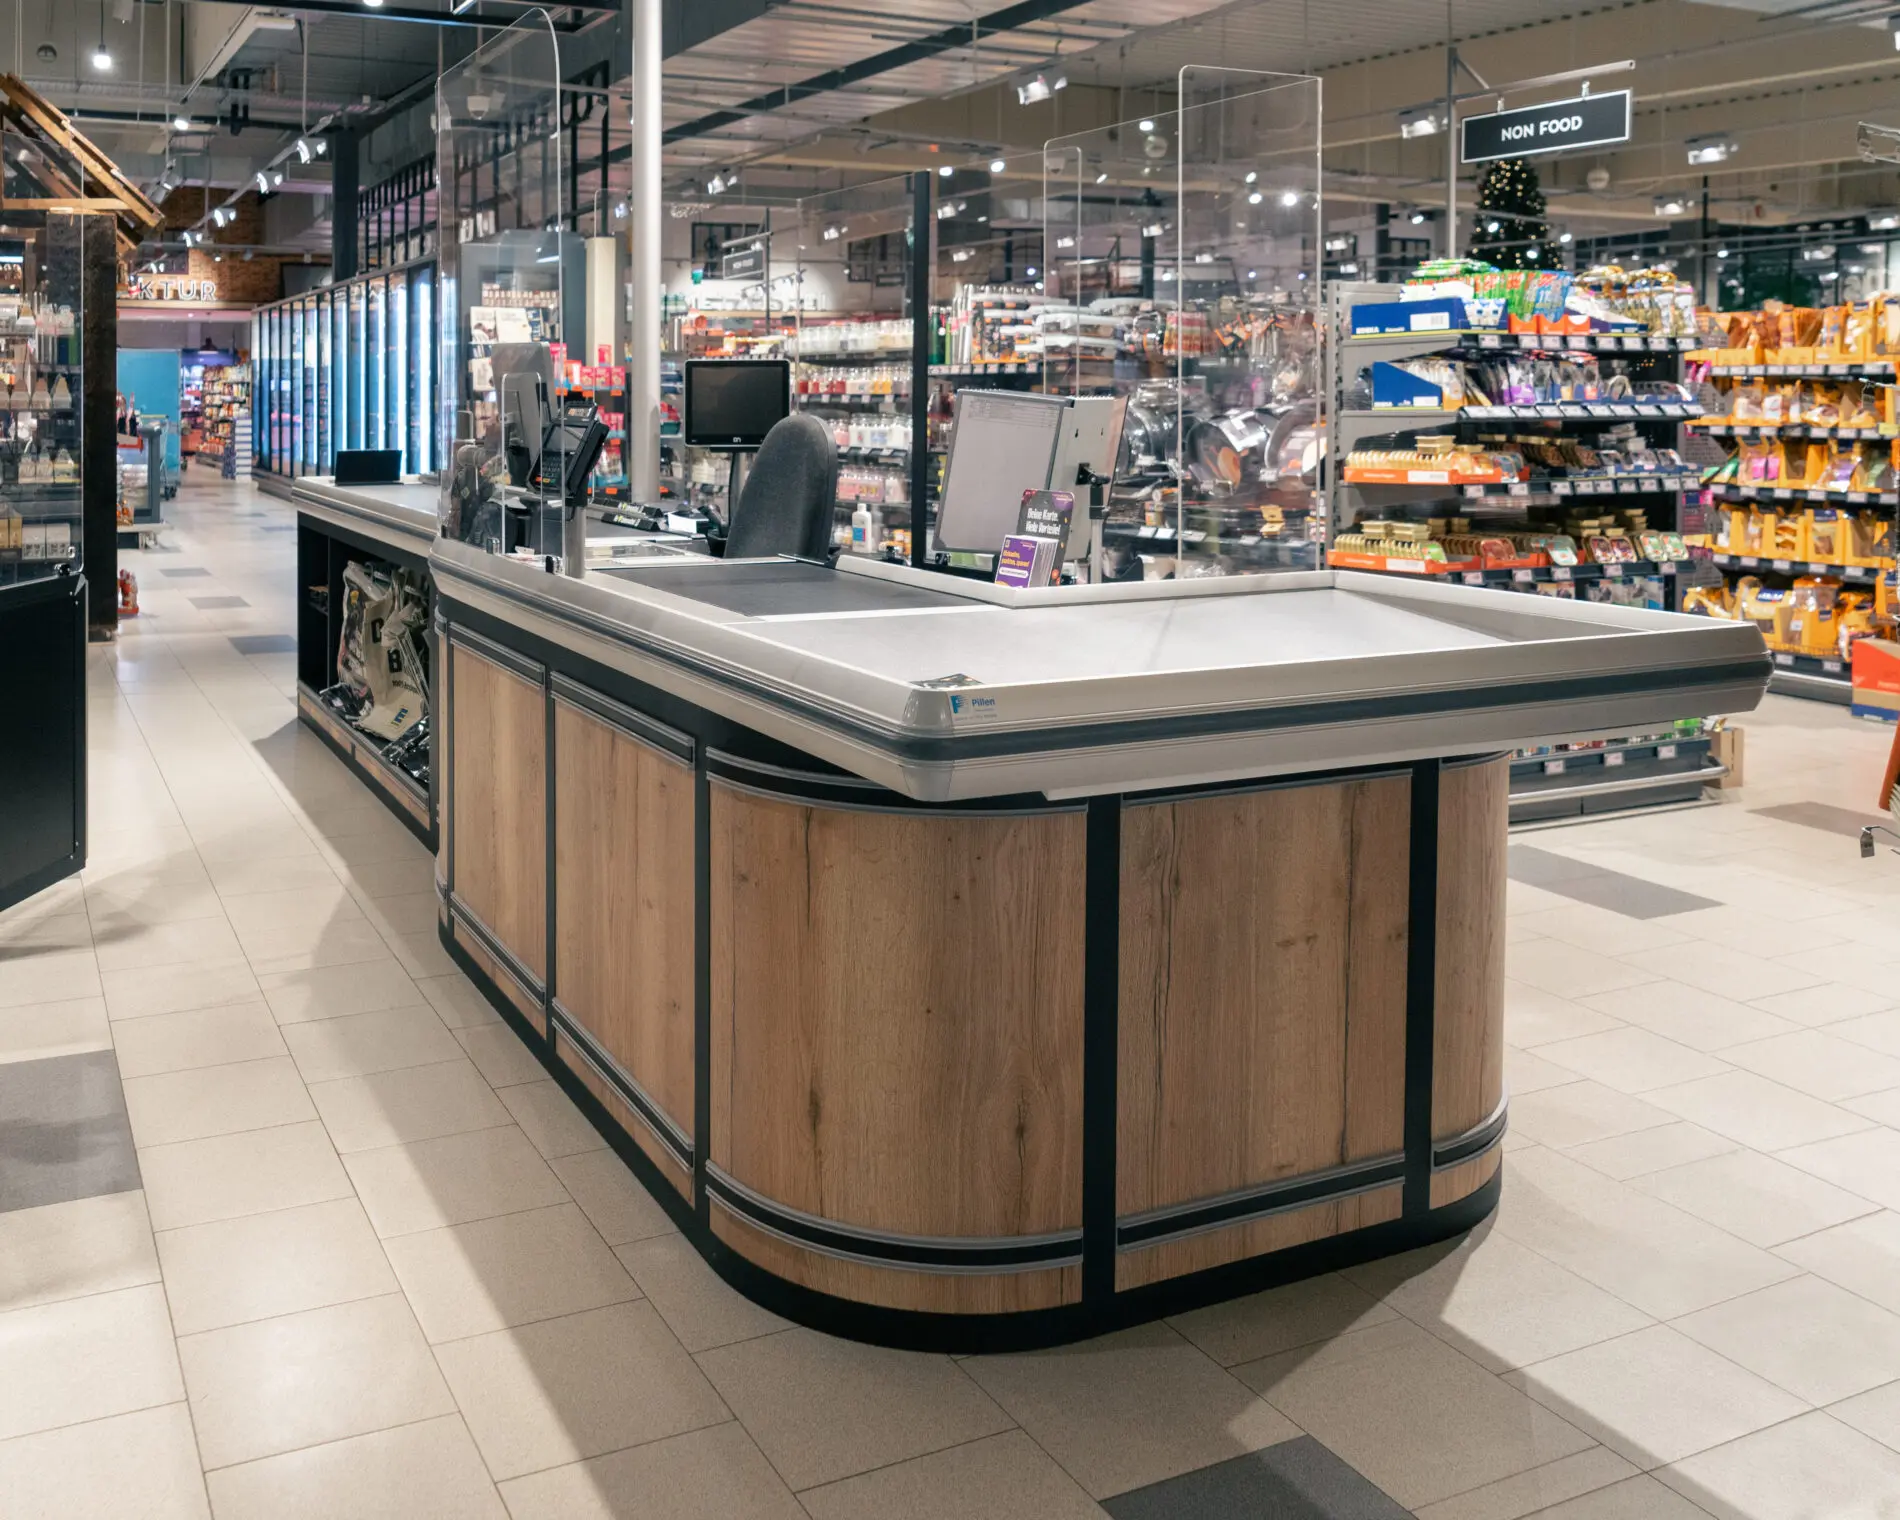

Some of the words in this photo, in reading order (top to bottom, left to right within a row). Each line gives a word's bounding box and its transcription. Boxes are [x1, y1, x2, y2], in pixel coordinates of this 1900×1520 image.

[1501, 123, 1535, 141] NON
[1539, 115, 1583, 136] FOOD
[971, 698, 996, 707] Pillen
